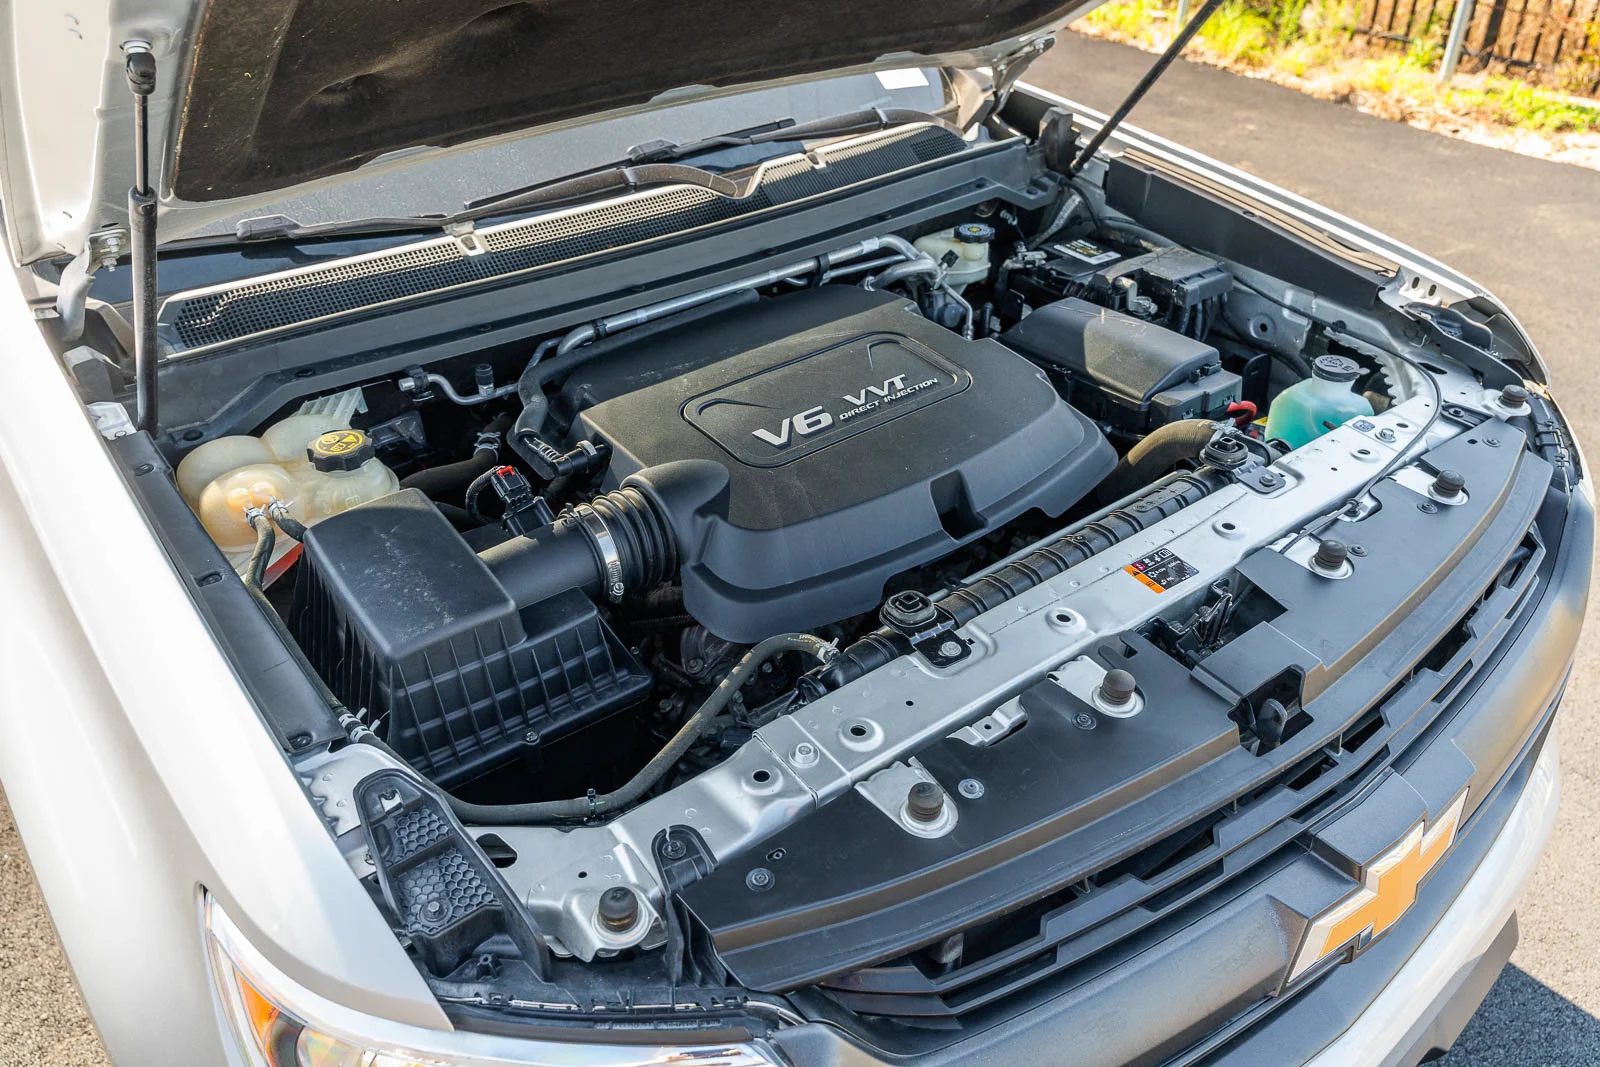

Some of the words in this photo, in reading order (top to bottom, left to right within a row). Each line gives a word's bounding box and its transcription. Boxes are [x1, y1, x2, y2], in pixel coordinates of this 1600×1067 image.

[839, 400, 880, 420] DIRECT
[884, 377, 938, 402] INJECTION
[842, 374, 906, 406] VVT
[751, 405, 833, 446] V6
